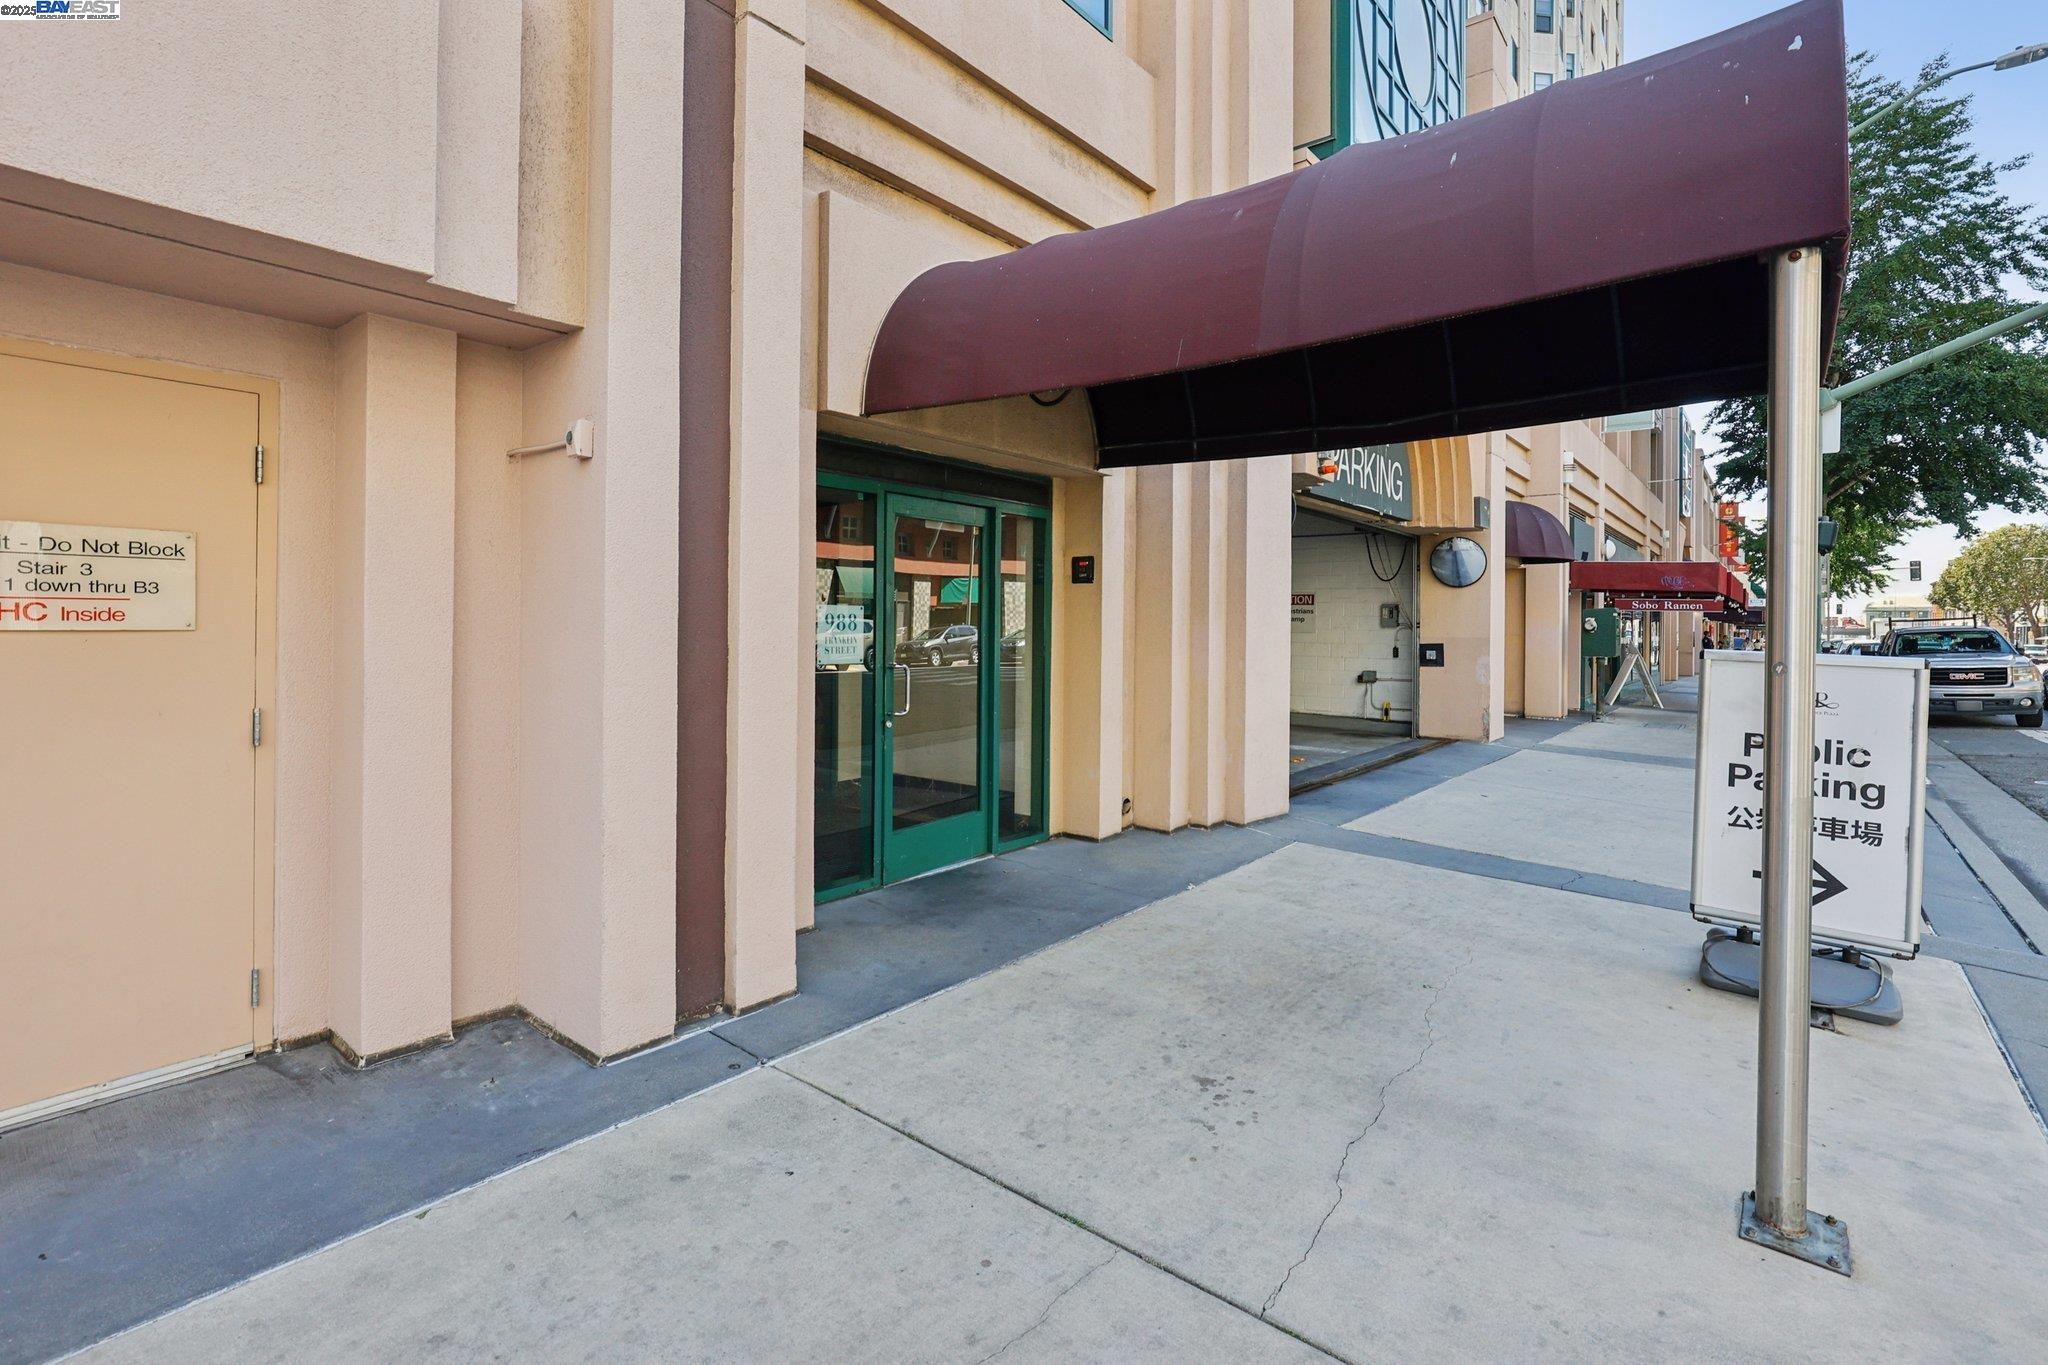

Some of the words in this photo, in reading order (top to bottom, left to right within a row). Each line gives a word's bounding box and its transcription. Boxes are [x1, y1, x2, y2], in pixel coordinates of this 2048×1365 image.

[39, 536, 72, 552] Do
[82, 539, 120, 554] Not
[129, 541, 186, 557] Block
[17, 560, 68, 575] Stair
[80, 563, 93, 576] 3
[25, 578, 81, 593] down
[89, 580, 126, 594] thru
[134, 581, 160, 595] B3
[1632, 600, 1659, 609] Sobo
[1664, 601, 1703, 610] Ramen
[61, 606, 126, 622] Inside
[824, 613, 857, 632] 988
[824, 646, 857, 655] STREET
[1743, 732, 1872, 769] Plic
